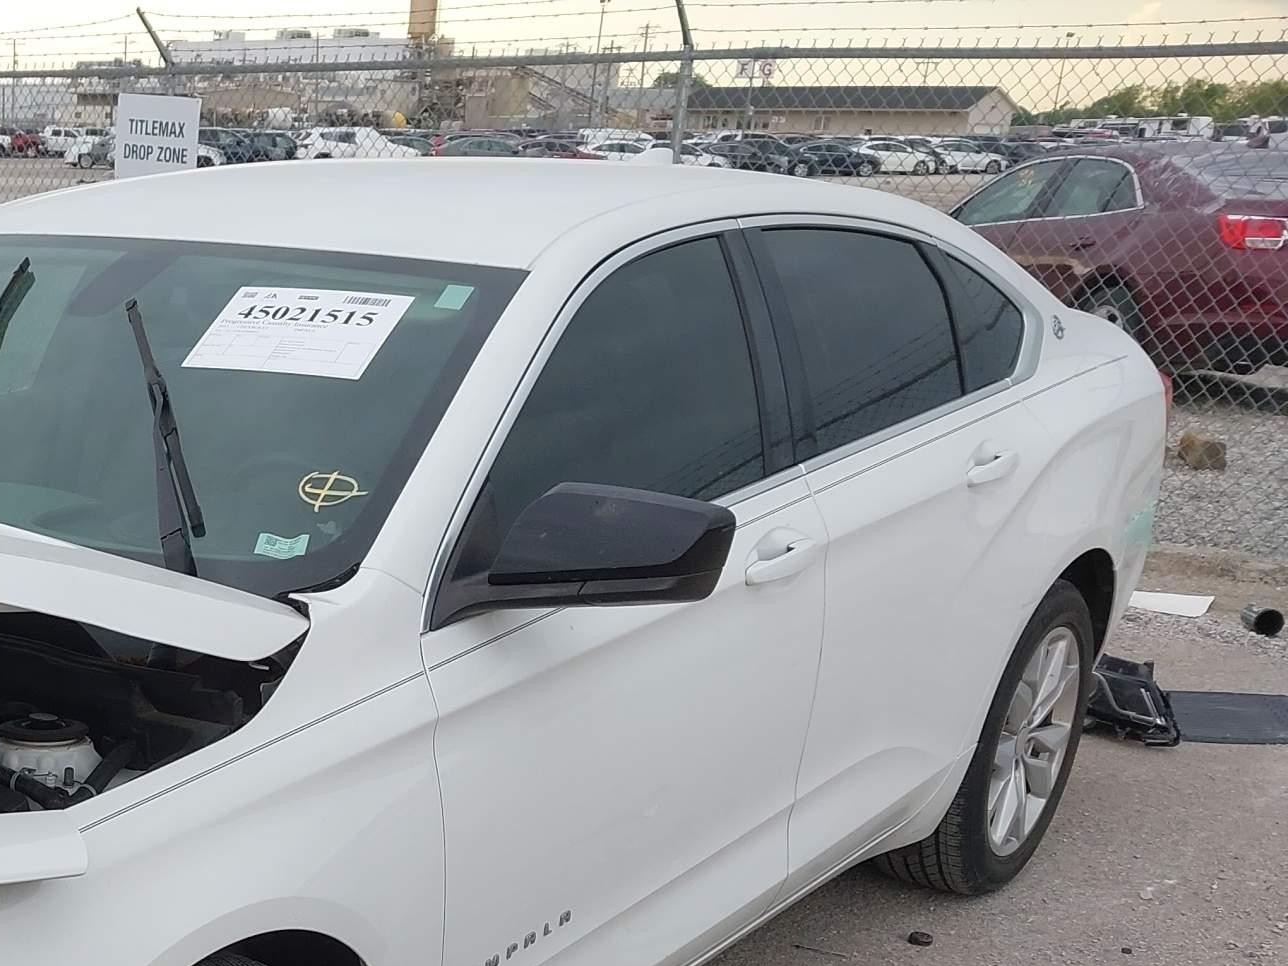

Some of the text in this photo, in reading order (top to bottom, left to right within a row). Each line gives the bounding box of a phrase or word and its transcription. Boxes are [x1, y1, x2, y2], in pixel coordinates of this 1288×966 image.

[740, 63, 749, 75] F
[762, 63, 772, 76] G
[129, 118, 185, 138] TITLEMAX
[123, 143, 188, 164] DROP ZONE
[238, 304, 379, 326] 45021515
